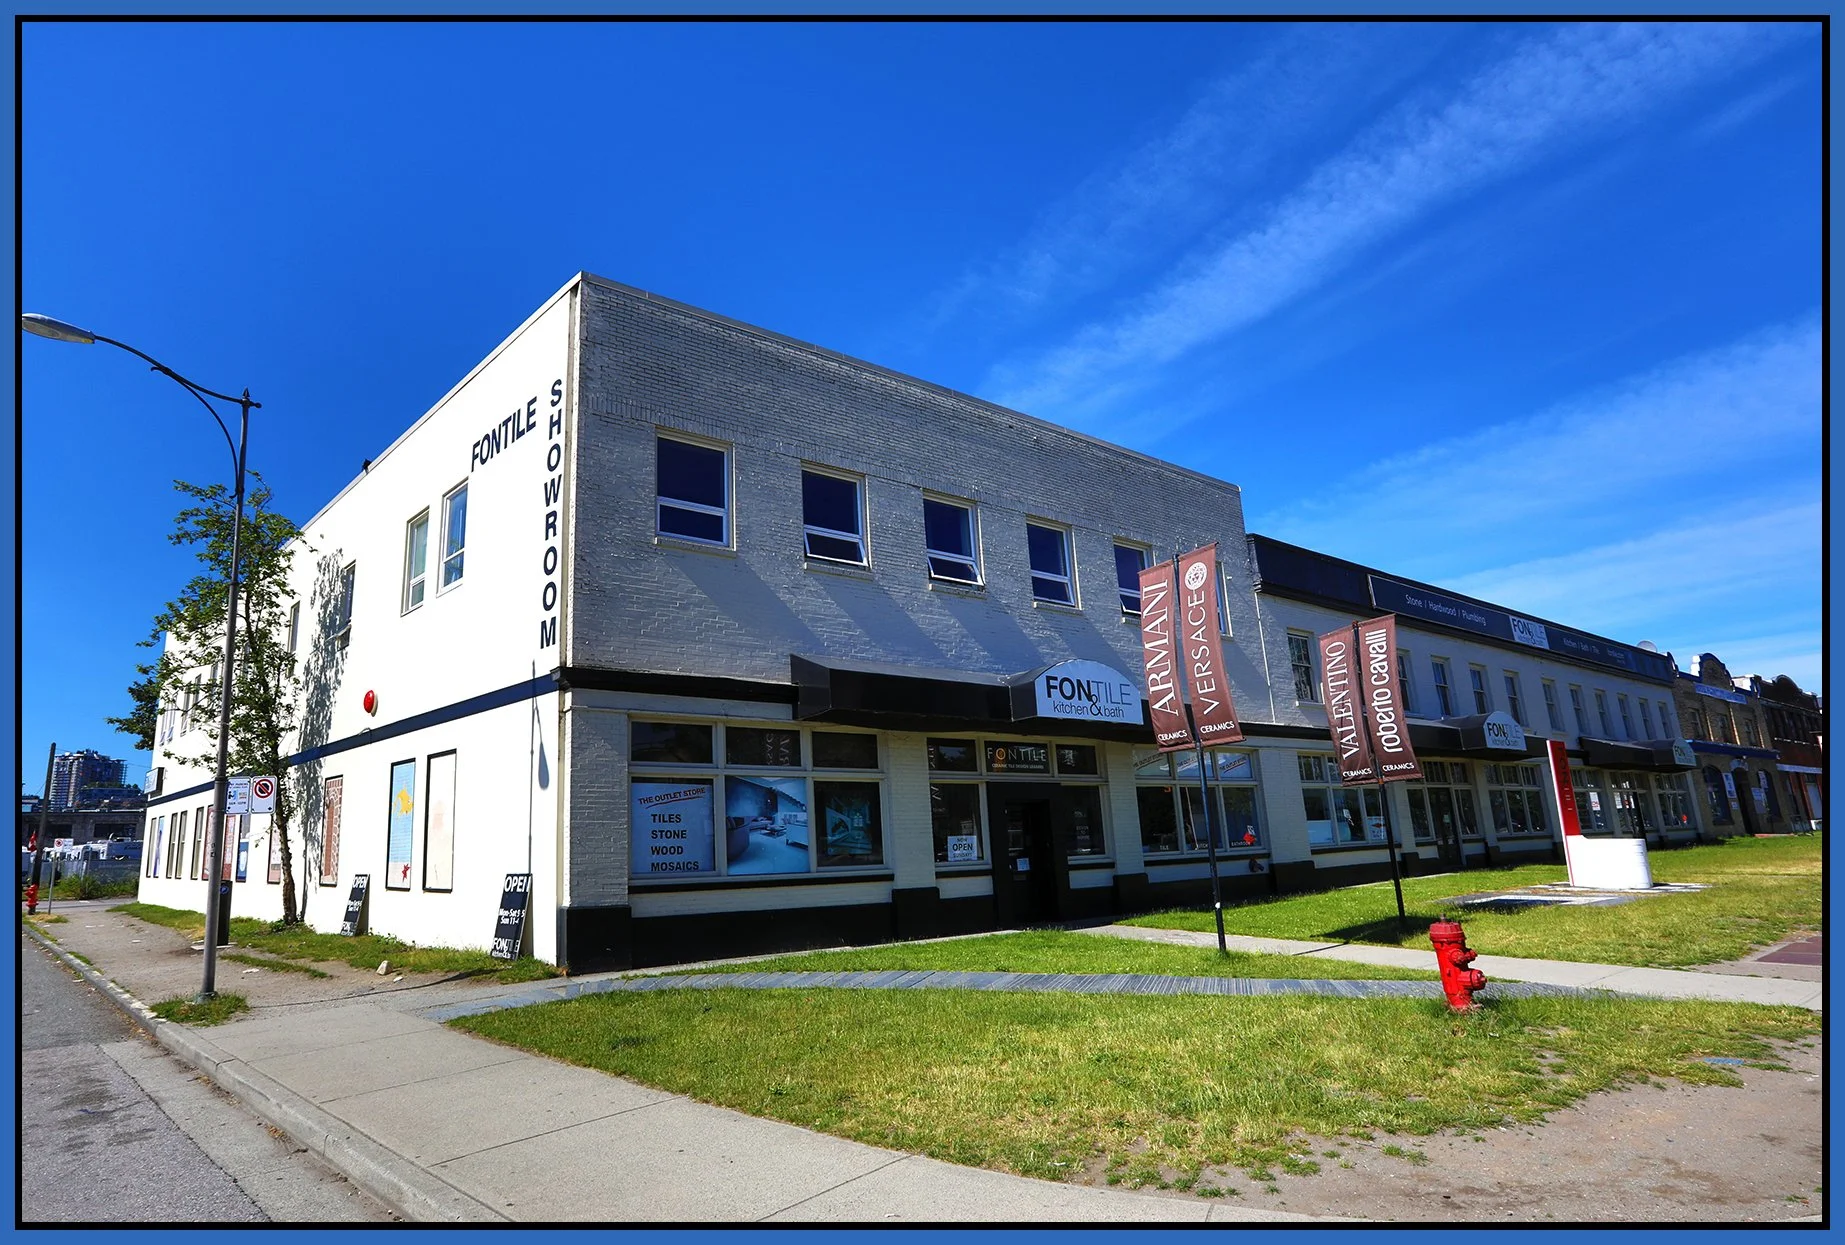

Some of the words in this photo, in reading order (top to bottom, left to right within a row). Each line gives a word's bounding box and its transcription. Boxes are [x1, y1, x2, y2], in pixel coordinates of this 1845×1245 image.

[471, 396, 538, 472] FONTILE
[540, 379, 562, 649] SHOWROOM
[1405, 594, 1423, 608] Stone
[1428, 601, 1457, 616] Hardwood
[1462, 610, 1487, 626] Plumbing
[1143, 579, 1179, 716] ARMANI
[1188, 590, 1220, 715] VERSACE
[1366, 628, 1390, 687] cavalli
[1046, 675, 1132, 706] FONTILE
[1053, 701, 1089, 716] kitchen
[1089, 694, 1103, 716] &
[1103, 705, 1125, 718] bath
[1326, 641, 1360, 760] VALENTINO
[1200, 720, 1235, 734] CERAMICS
[1370, 688, 1403, 753] roberto
[1157, 729, 1188, 741] CERAMICS
[987, 747, 1047, 762] FONTILE
[1342, 767, 1372, 778] CERAMICS
[1382, 761, 1415, 773] CERAMICS
[638, 796, 654, 805] THE
[655, 791, 682, 802] OUTLET
[683, 787, 706, 797] STORE
[651, 813, 682, 823] TILES
[651, 830, 687, 839] STONE
[651, 846, 684, 855] WOOD
[952, 843, 973, 851] OPEN
[651, 861, 699, 871] MOSAICS
